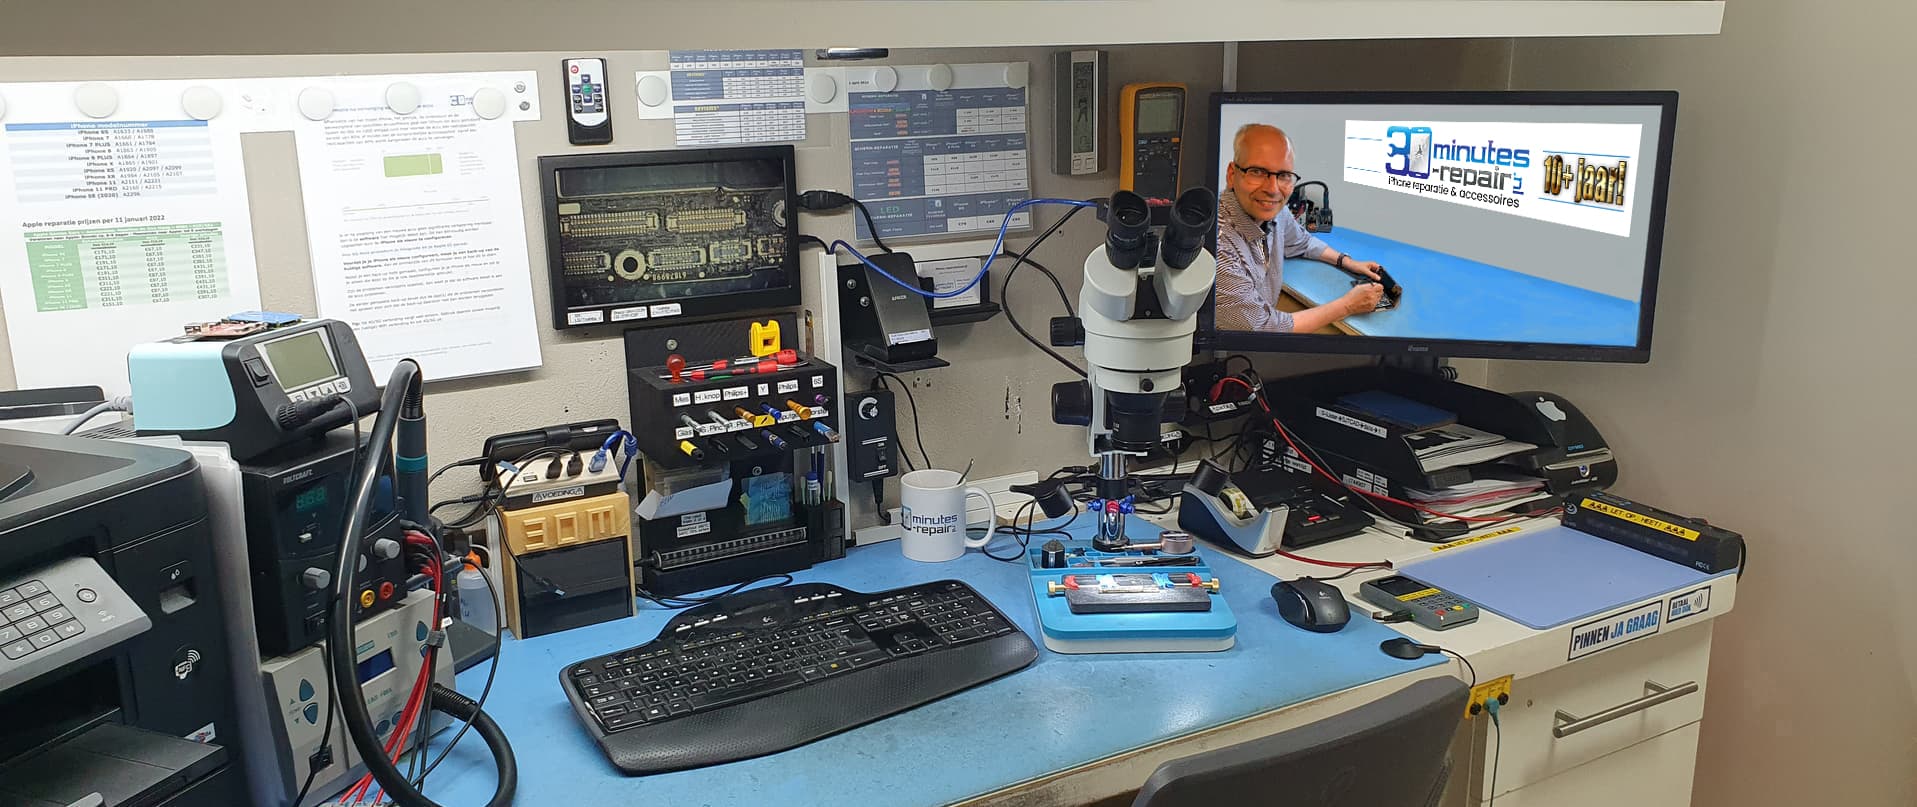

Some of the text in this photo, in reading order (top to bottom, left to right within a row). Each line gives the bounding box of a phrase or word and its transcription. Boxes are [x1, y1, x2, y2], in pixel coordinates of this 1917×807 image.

[1433, 139, 1530, 168] minutes
[1388, 176, 1520, 208] iPhone reparatie & accessoires
[1544, 154, 1628, 206] 10+ jaar!
[542, 490, 576, 499] VOEDING
[913, 514, 957, 524] minutes
[1573, 610, 1659, 652] PINNEN JA GRAAG
